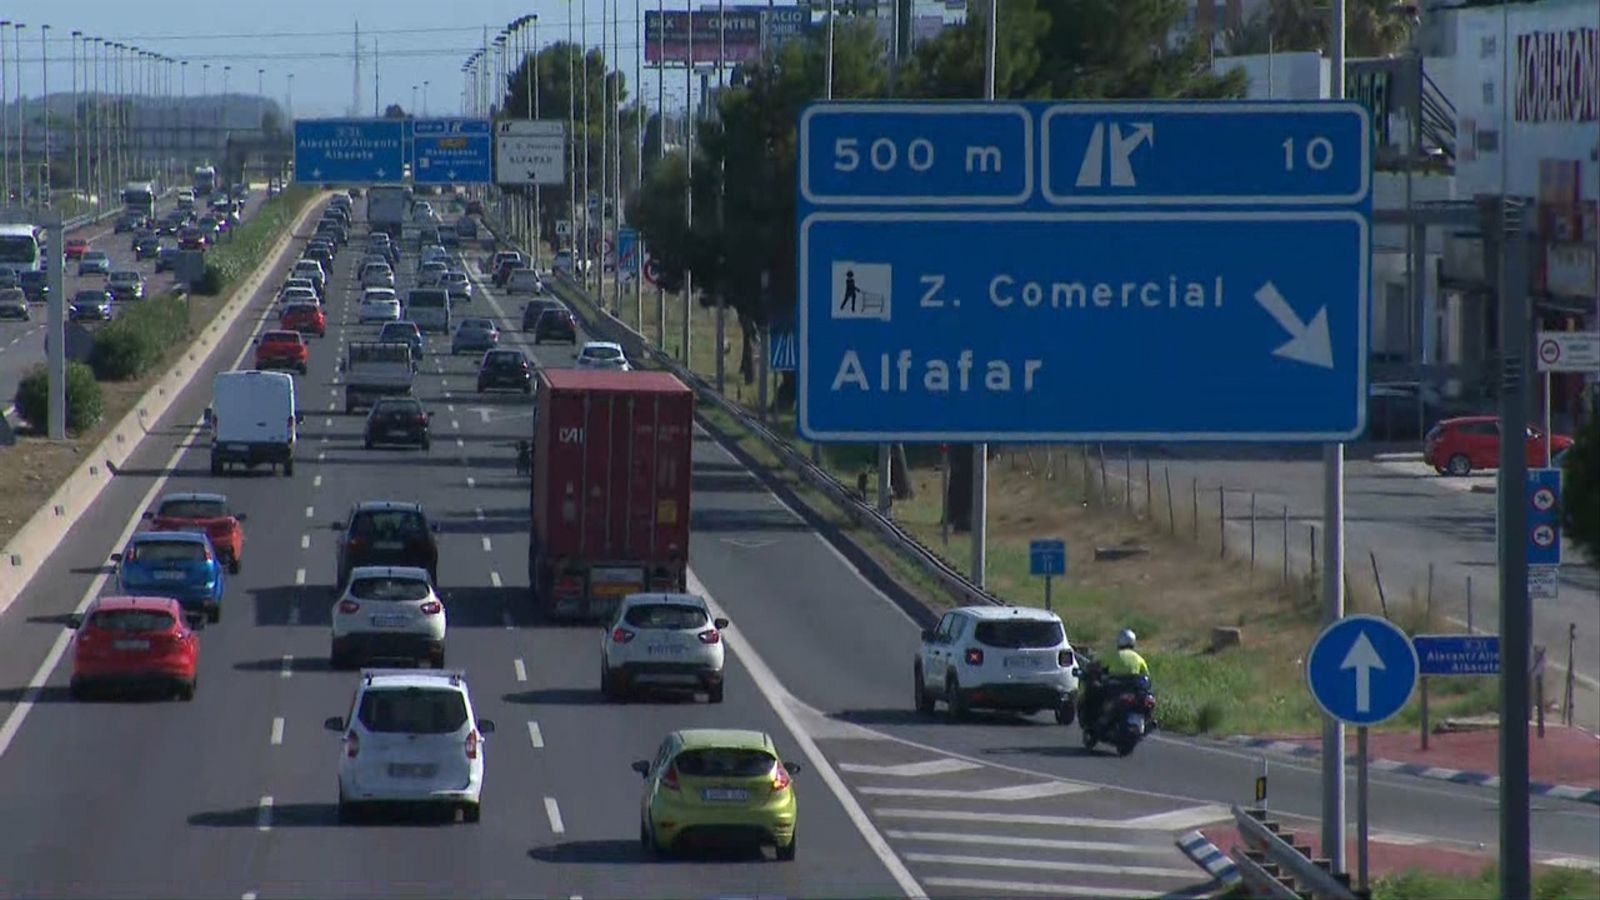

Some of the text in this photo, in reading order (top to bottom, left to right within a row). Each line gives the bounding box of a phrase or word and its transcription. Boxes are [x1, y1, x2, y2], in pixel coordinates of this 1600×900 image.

[1515, 29, 1598, 122] MOBLERON
[325, 149, 374, 160] Albacete
[833, 137, 1002, 173] 500 m
[1282, 136, 1335, 171] 10
[919, 274, 1225, 309] Z. Comercial
[831, 349, 1043, 393] Alfafar
